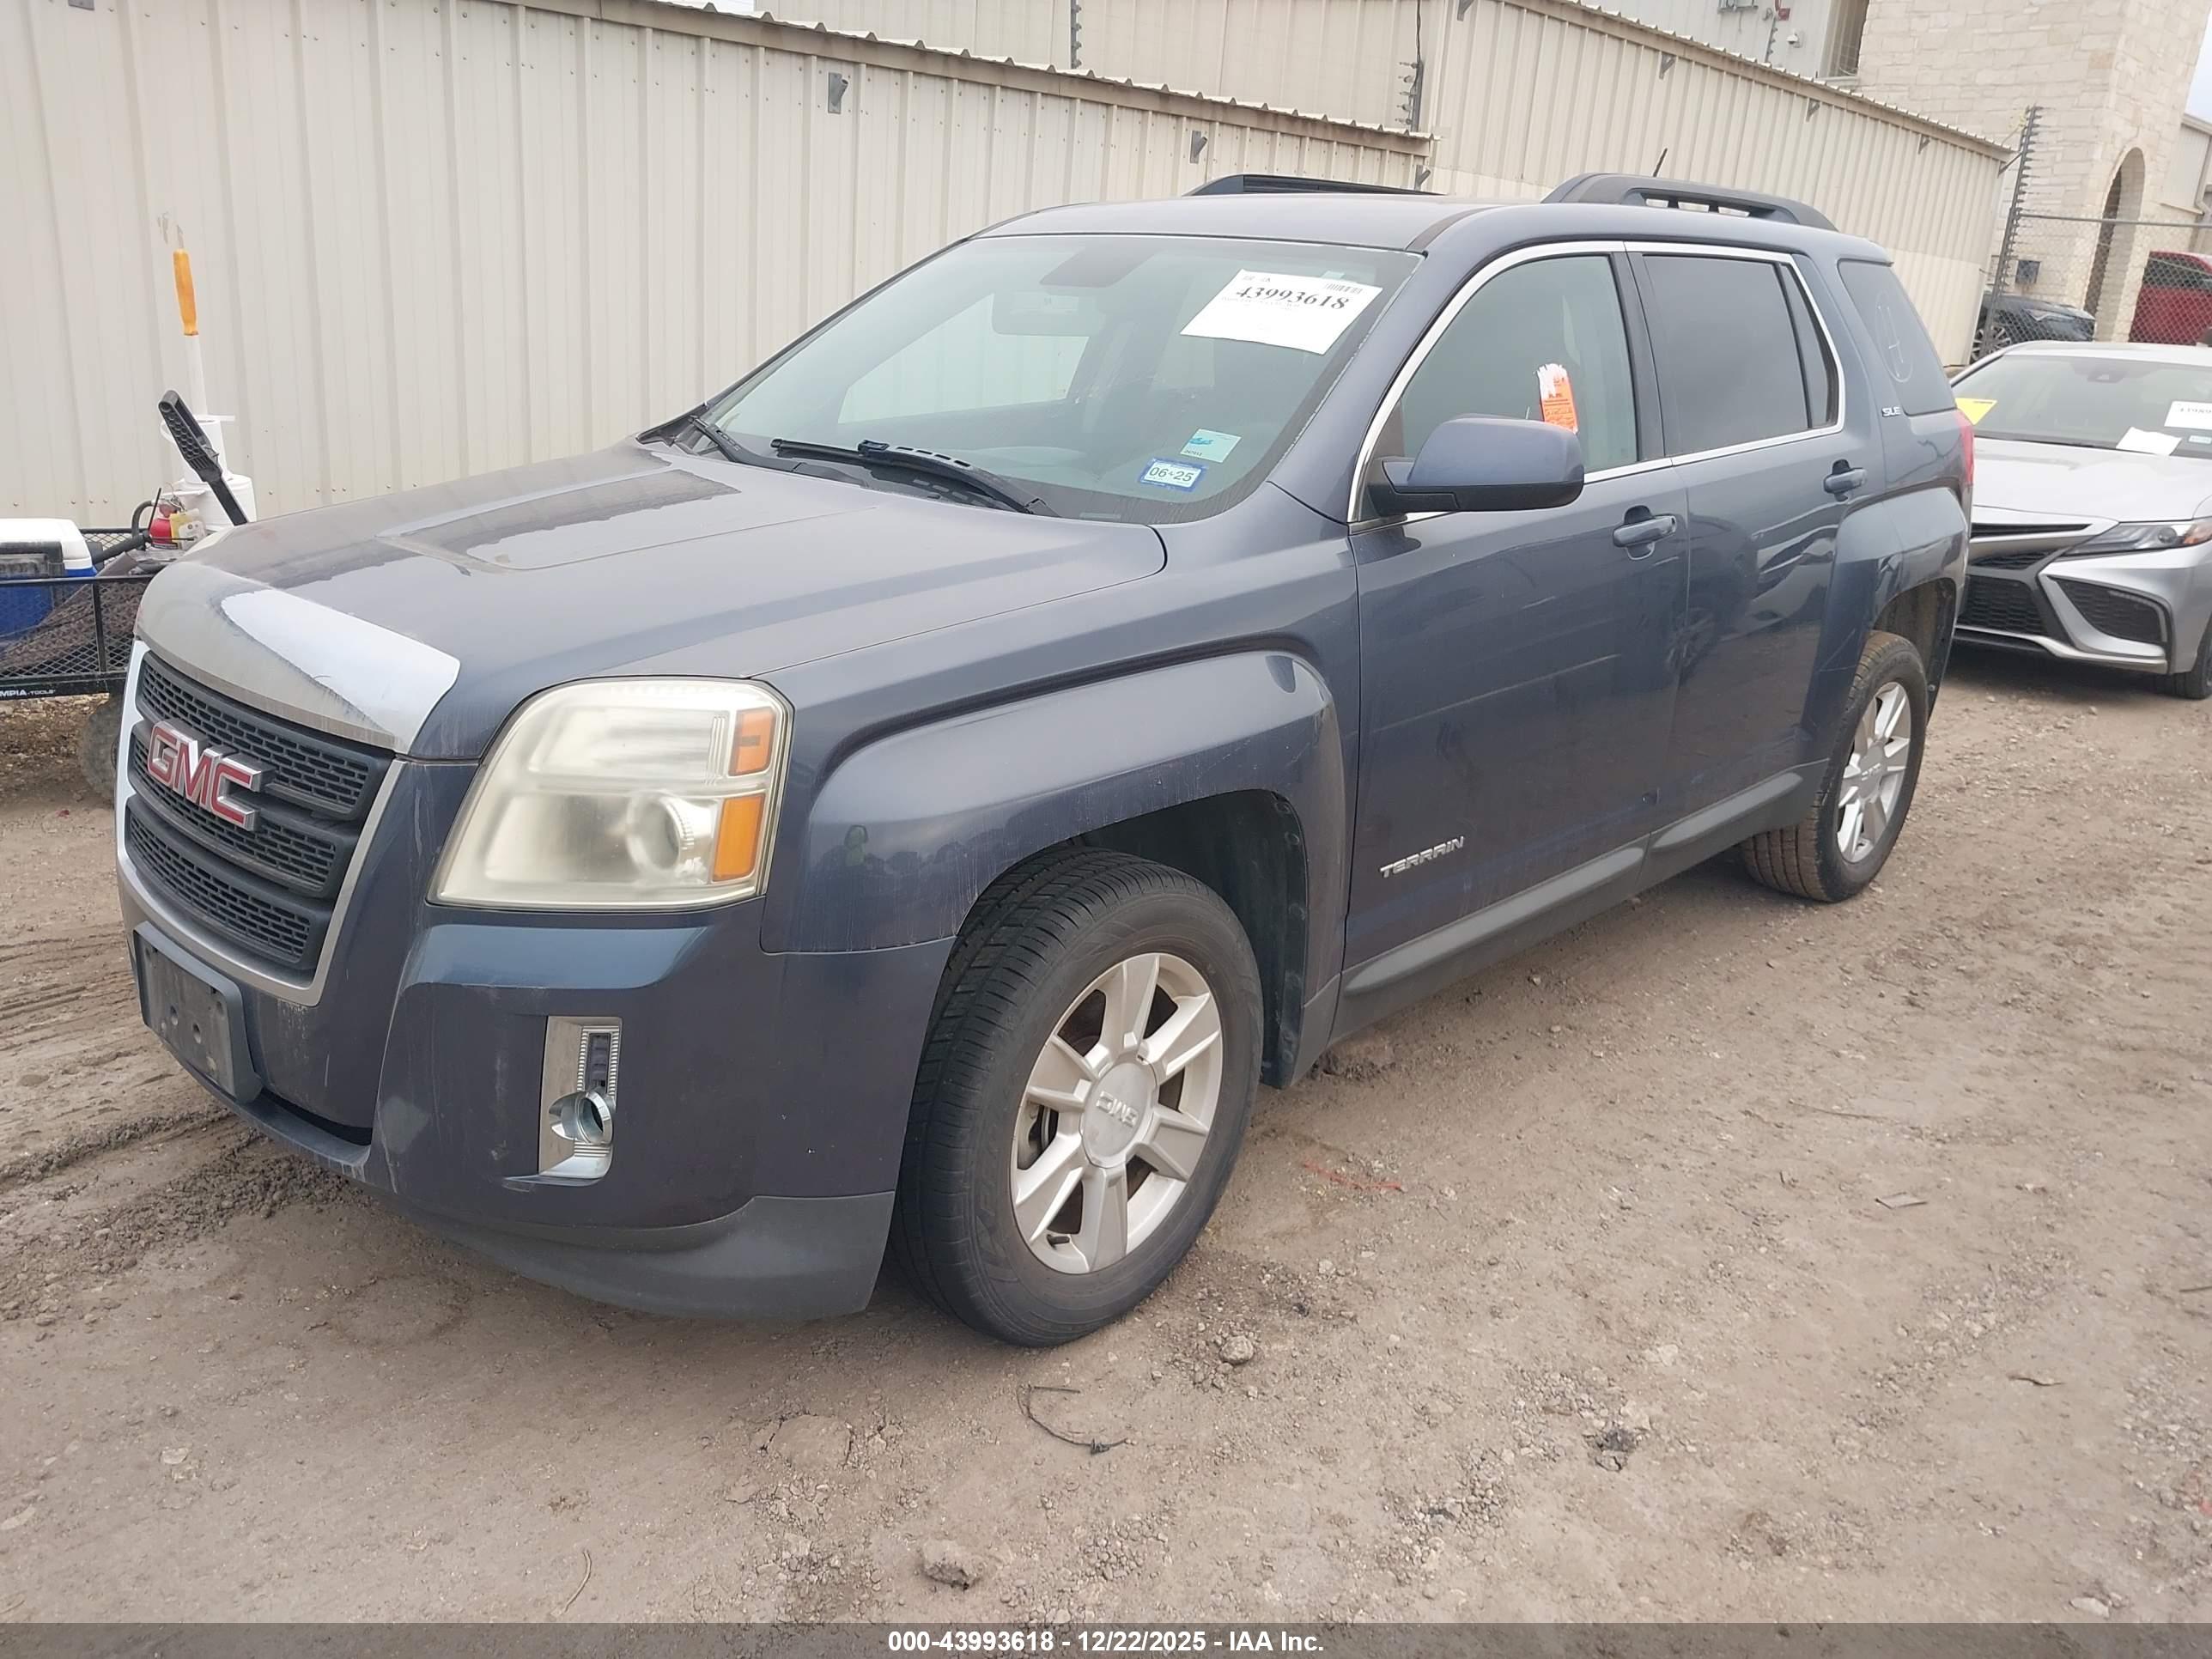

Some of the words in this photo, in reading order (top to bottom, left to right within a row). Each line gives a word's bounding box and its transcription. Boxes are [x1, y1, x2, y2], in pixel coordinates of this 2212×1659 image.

[1236, 286, 1350, 310] 43993618
[1881, 405, 1901, 417] SLE
[147, 720, 262, 832] GMC
[1379, 835, 1465, 878] TERRAIN
